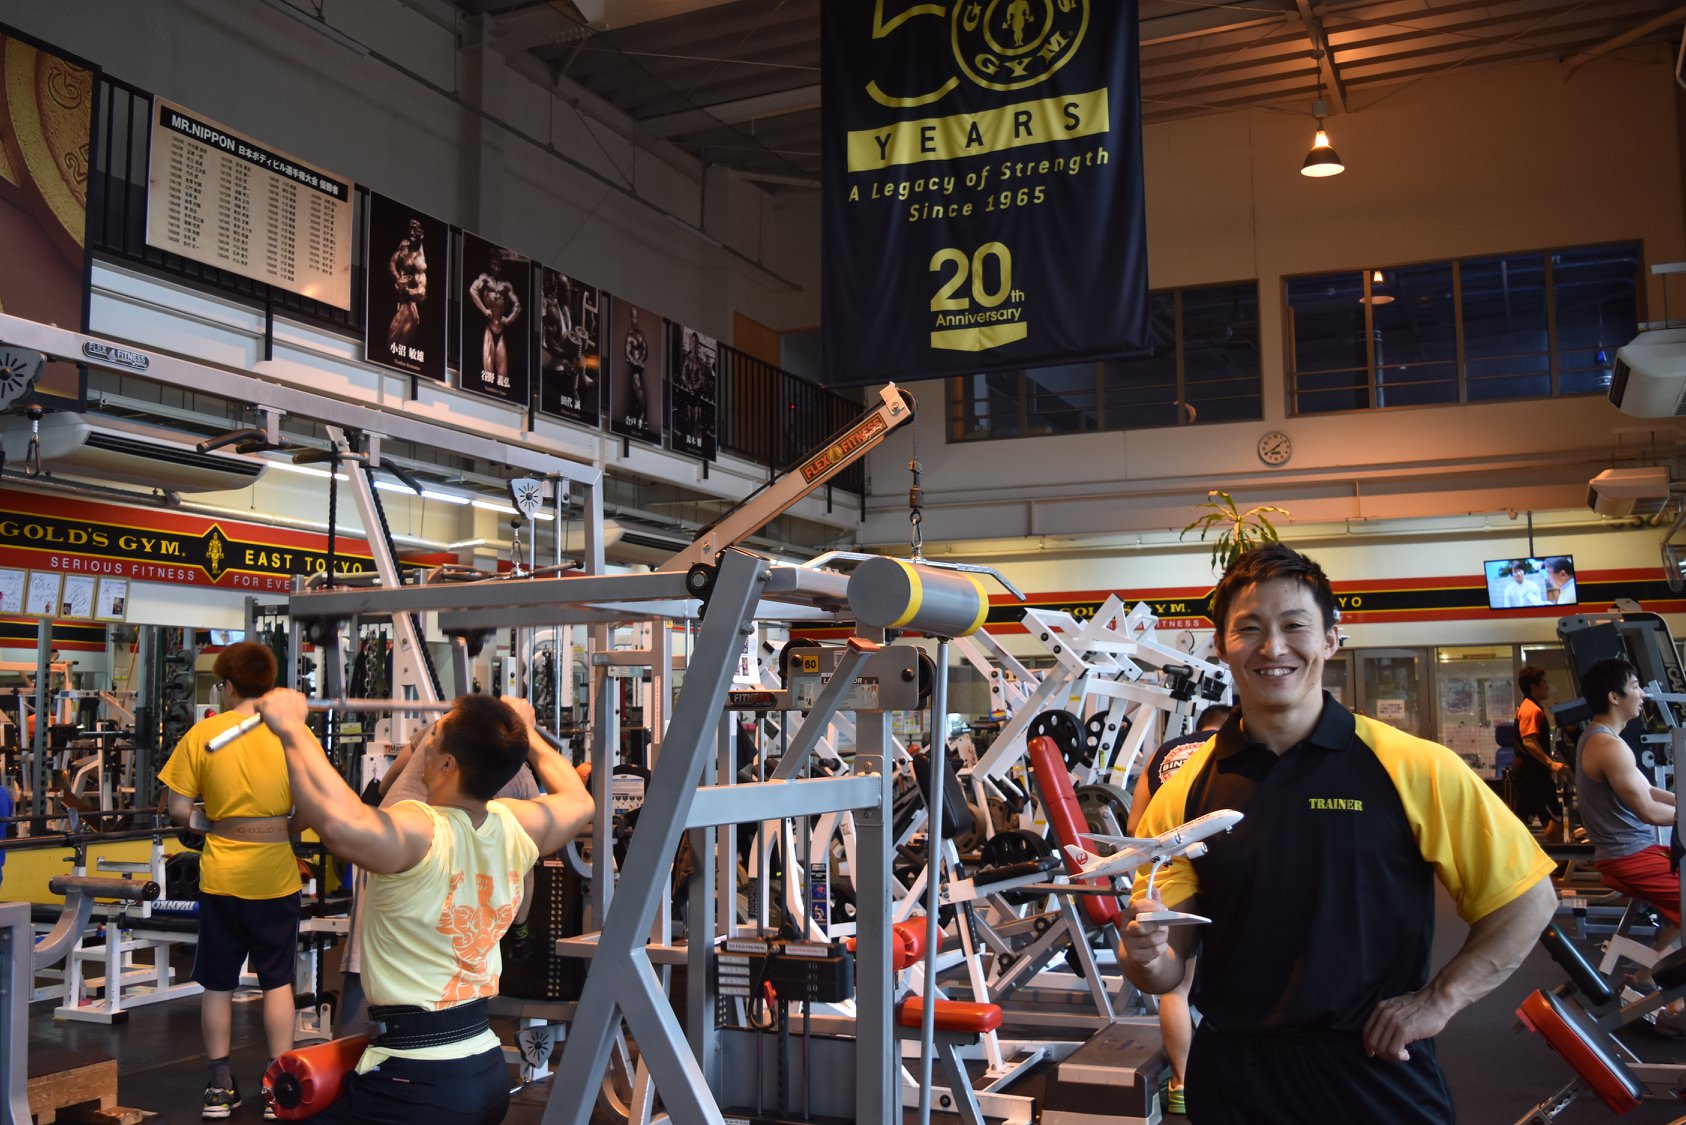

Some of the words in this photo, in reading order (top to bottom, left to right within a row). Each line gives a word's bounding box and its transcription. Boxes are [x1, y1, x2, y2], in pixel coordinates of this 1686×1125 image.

[171, 114, 236, 152] MR.NIPPON
[874, 102, 1081, 160] YEARS
[849, 184, 860, 202] A
[872, 176, 955, 200] Legacy
[966, 166, 990, 190] of
[1000, 147, 1109, 180] Strength
[909, 202, 973, 222] Since
[985, 185, 1046, 212] 1965
[935, 307, 1022, 327] Anniversary
[804, 454, 831, 479] FLEX
[841, 418, 881, 453] FITNESS
[0, 521, 109, 548] GOLD'S
[51, 556, 123, 574] SERIOUS
[132, 564, 195, 581] FITNESS
[245, 549, 293, 569] EAST
[305, 557, 363, 573] TOYO
[233, 575, 259, 587] FOR
[267, 578, 290, 590] EVE
[1157, 619, 1200, 627] ITNESS
[804, 659, 816, 669] 60
[1309, 798, 1363, 811] TRAINER
